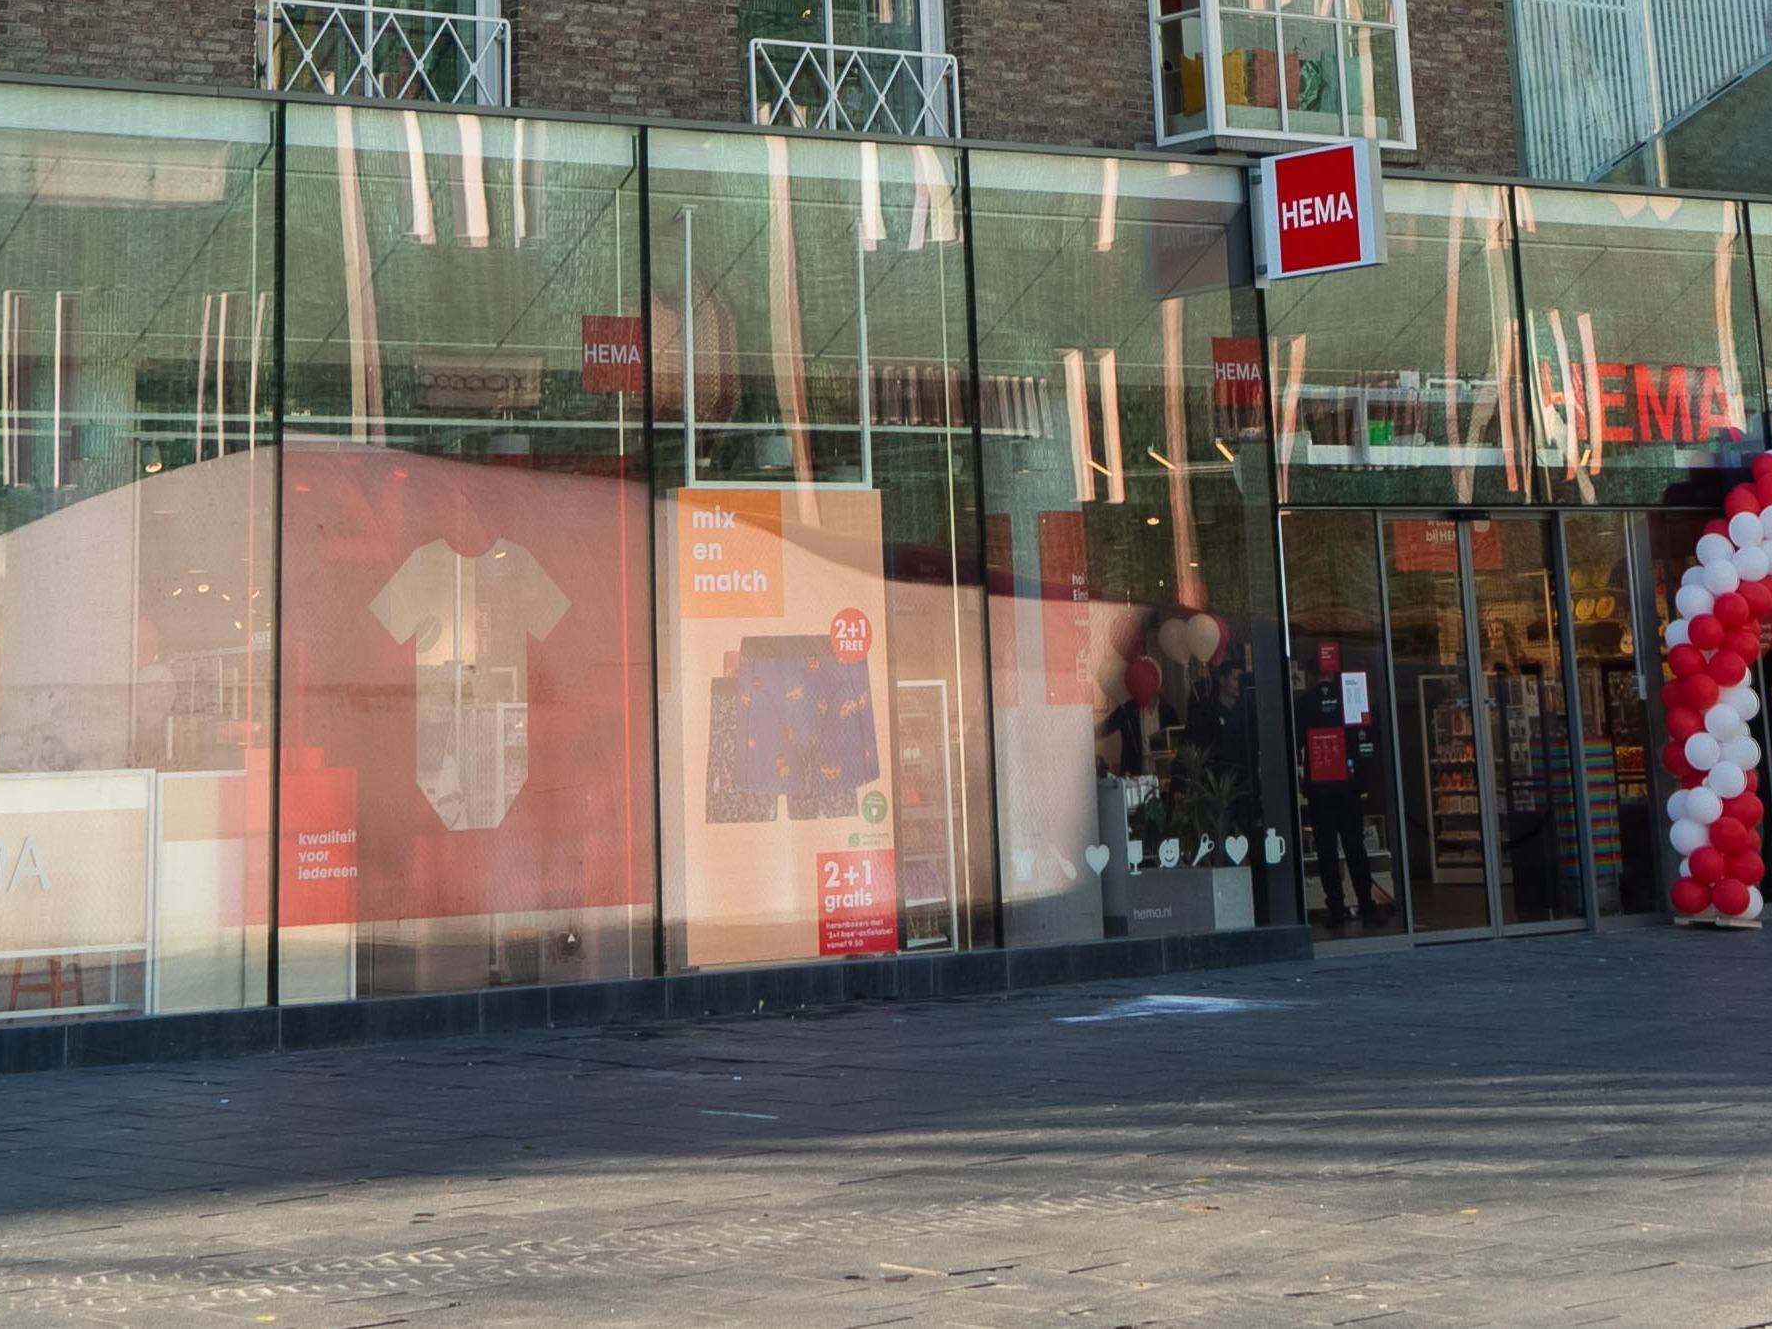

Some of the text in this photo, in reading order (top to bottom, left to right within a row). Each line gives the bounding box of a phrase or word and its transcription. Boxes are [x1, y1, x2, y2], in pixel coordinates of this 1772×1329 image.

[1281, 191, 1353, 230] HEMA
[584, 343, 641, 364] HEMA
[1215, 362, 1261, 380] HEMA
[1540, 360, 1742, 442] HEMA
[692, 504, 736, 529] mix
[692, 542, 723, 560] en
[693, 569, 767, 591] match
[835, 619, 866, 638] 2+1
[839, 640, 864, 651] FREE
[298, 829, 357, 845] kwaliteit
[298, 850, 330, 862] voor
[298, 865, 358, 880] iedereen
[824, 859, 872, 888] 2+1
[824, 887, 873, 913] gratis
